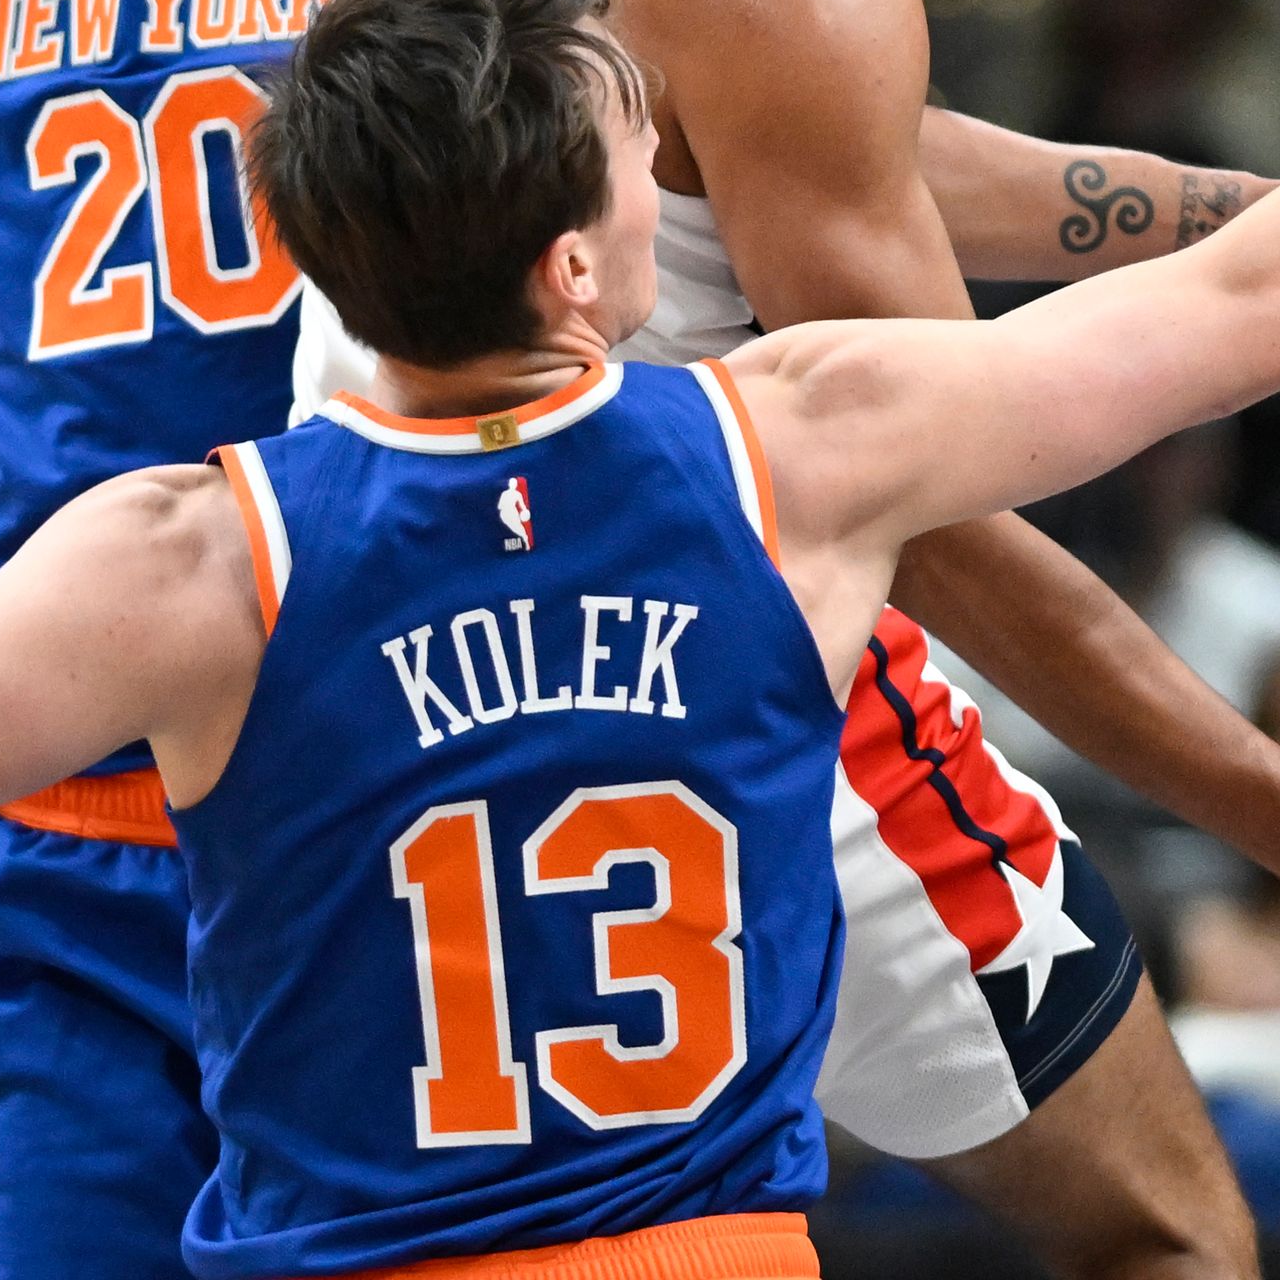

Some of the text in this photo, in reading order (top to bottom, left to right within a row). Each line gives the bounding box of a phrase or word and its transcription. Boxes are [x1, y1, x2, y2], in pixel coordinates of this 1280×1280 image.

[26, 65, 305, 362] 20
[504, 537, 523, 552] NBA
[381, 595, 698, 749] KOLEK
[389, 779, 747, 1149] 13
